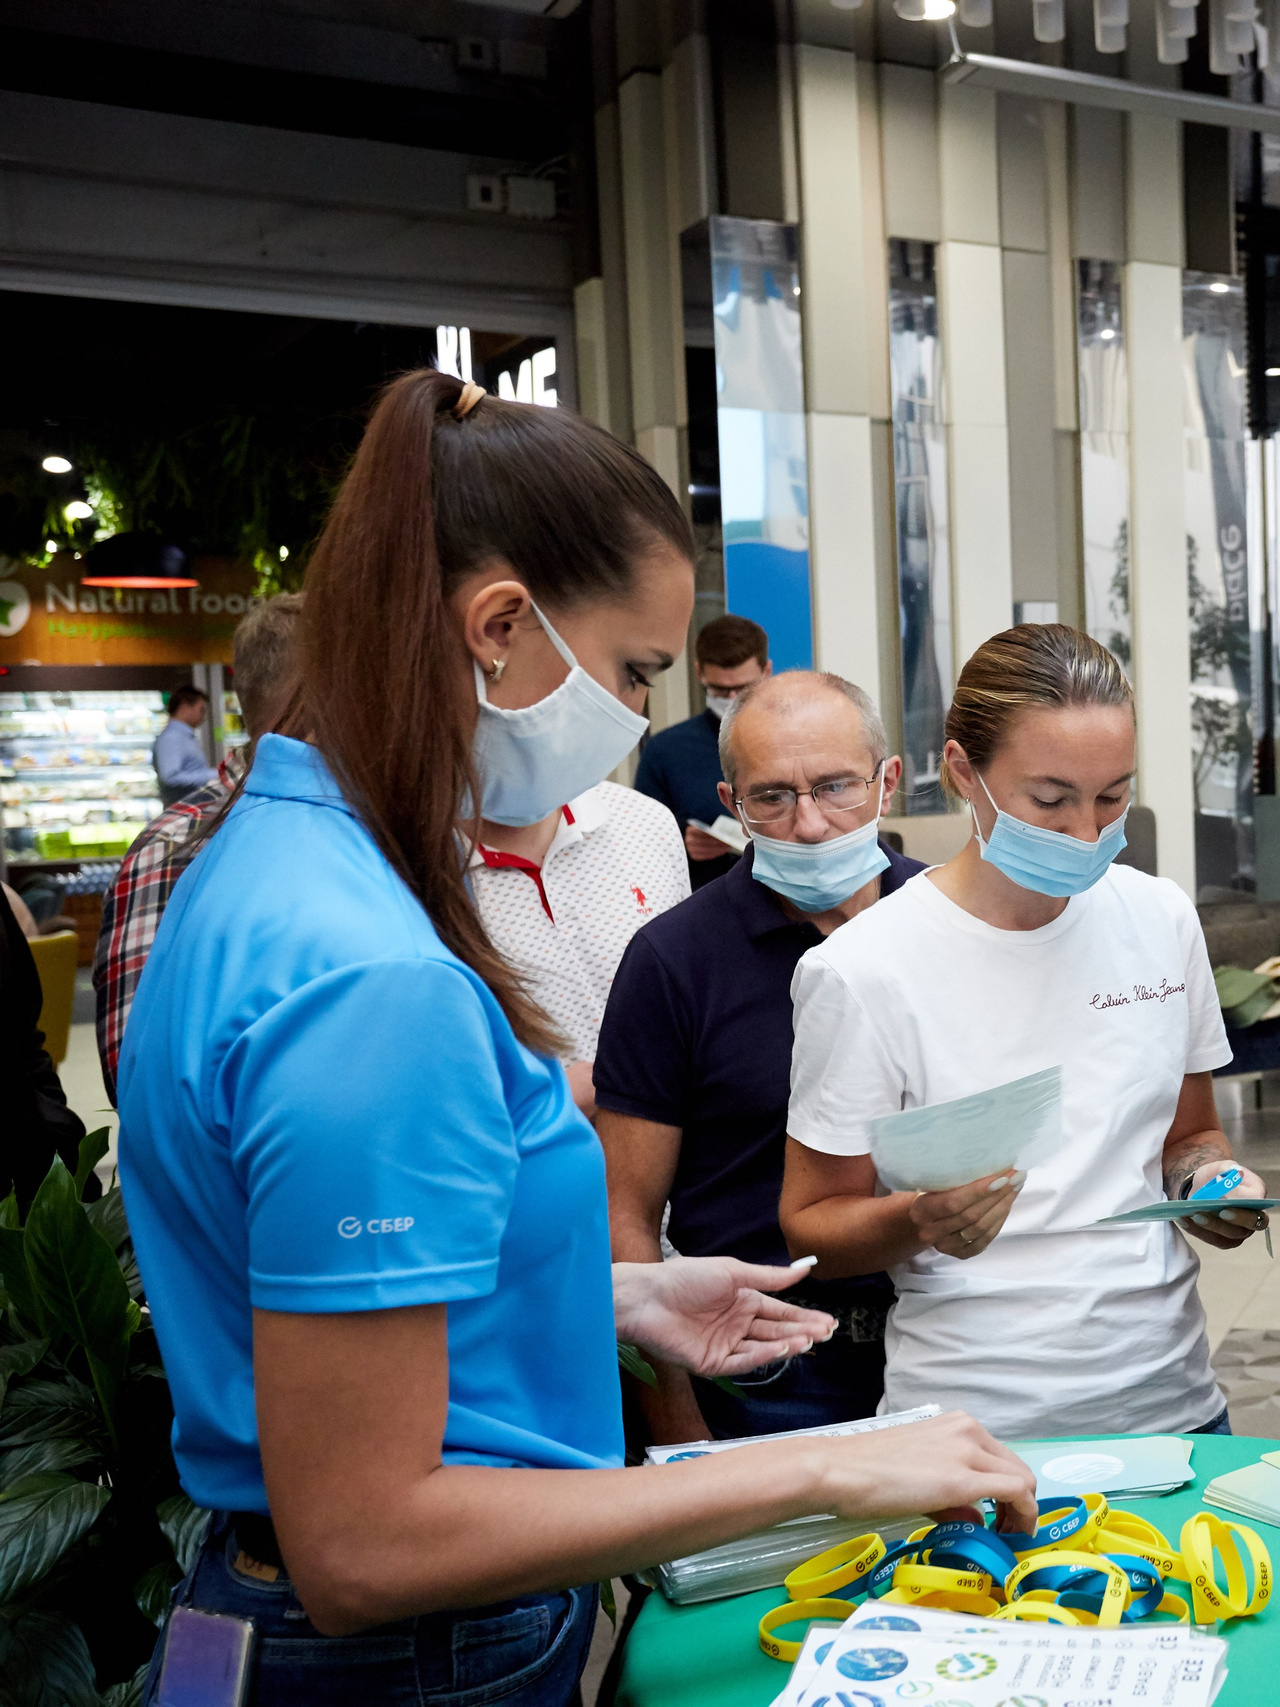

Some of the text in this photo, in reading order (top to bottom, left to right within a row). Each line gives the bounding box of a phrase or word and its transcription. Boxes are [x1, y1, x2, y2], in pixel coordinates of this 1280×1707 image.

[45, 581, 182, 614] Natural
[1089, 978, 1186, 1010] Calvin Klein Jeans
[366, 1216, 415, 1234] СБЕР
[1062, 1517, 1080, 1533] СБЕР
[874, 1563, 894, 1581] СБЕР
[1260, 1561, 1268, 1587] СБЕР
[957, 1578, 976, 1588] СБЕР
[1203, 1586, 1220, 1607] СБЕР
